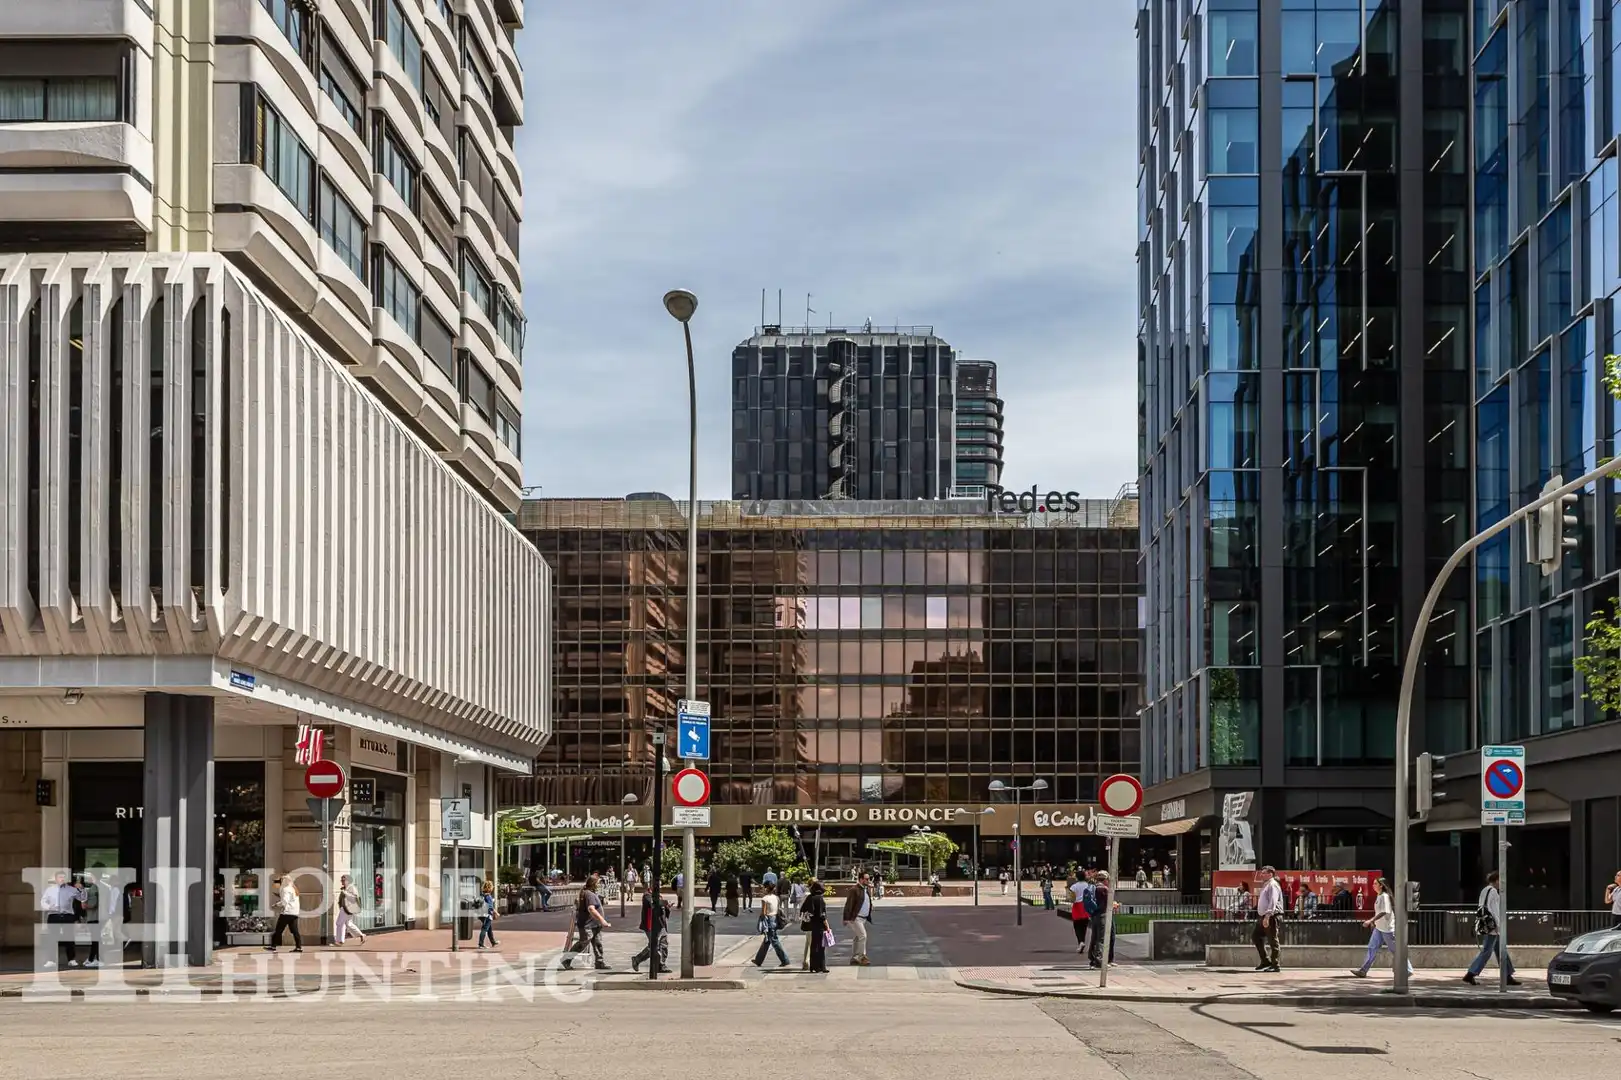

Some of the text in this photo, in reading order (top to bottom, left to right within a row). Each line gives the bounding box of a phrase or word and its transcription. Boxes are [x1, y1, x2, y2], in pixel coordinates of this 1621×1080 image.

[987, 484, 1080, 513] red.es
[531, 815, 547, 829] El
[547, 813, 583, 829] Corte
[766, 807, 956, 822] EDIFICIO BRONCE
[1034, 810, 1050, 827] El
[1051, 811, 1086, 827] Corte
